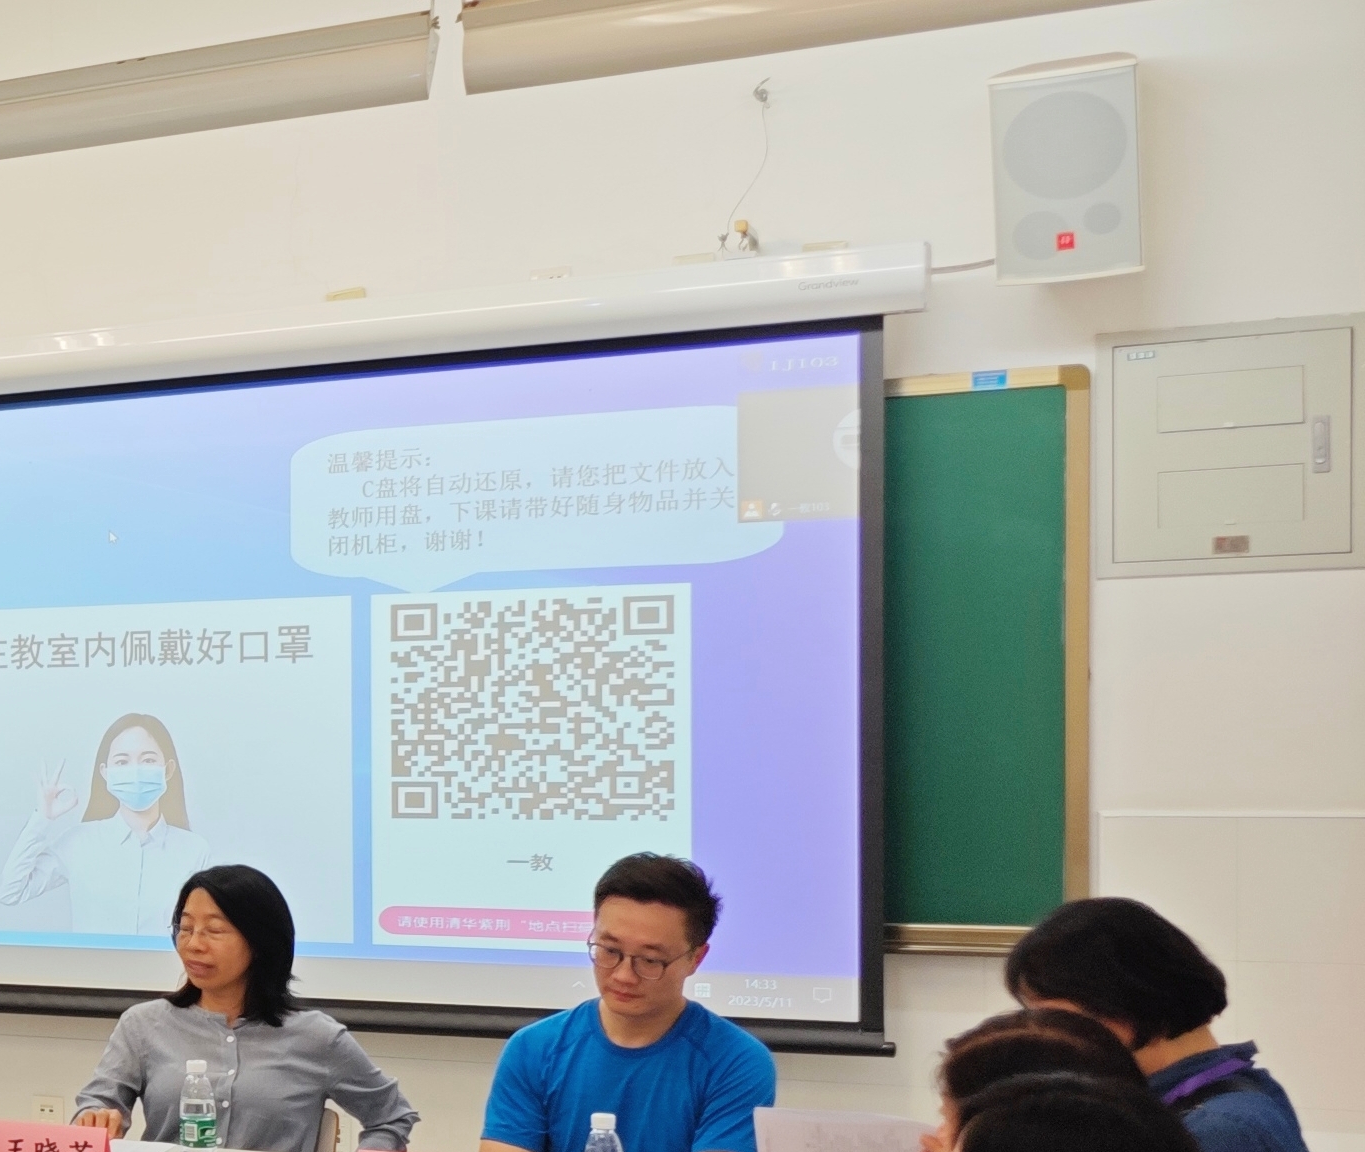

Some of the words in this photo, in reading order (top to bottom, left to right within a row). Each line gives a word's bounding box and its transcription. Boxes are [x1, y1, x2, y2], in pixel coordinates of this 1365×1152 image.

[327, 448, 432, 476] 温馨提示：
[361, 456, 736, 499] C盘将自动还原，请您把文件放入
[327, 487, 736, 531] 教师用盘，下课请带好随身物品并关
[327, 530, 485, 558] 闭机柜，谢谢！
[506, 853, 553, 872] 一教
[744, 979, 778, 991] 14:33
[728, 995, 792, 1009] 2023/5/11
